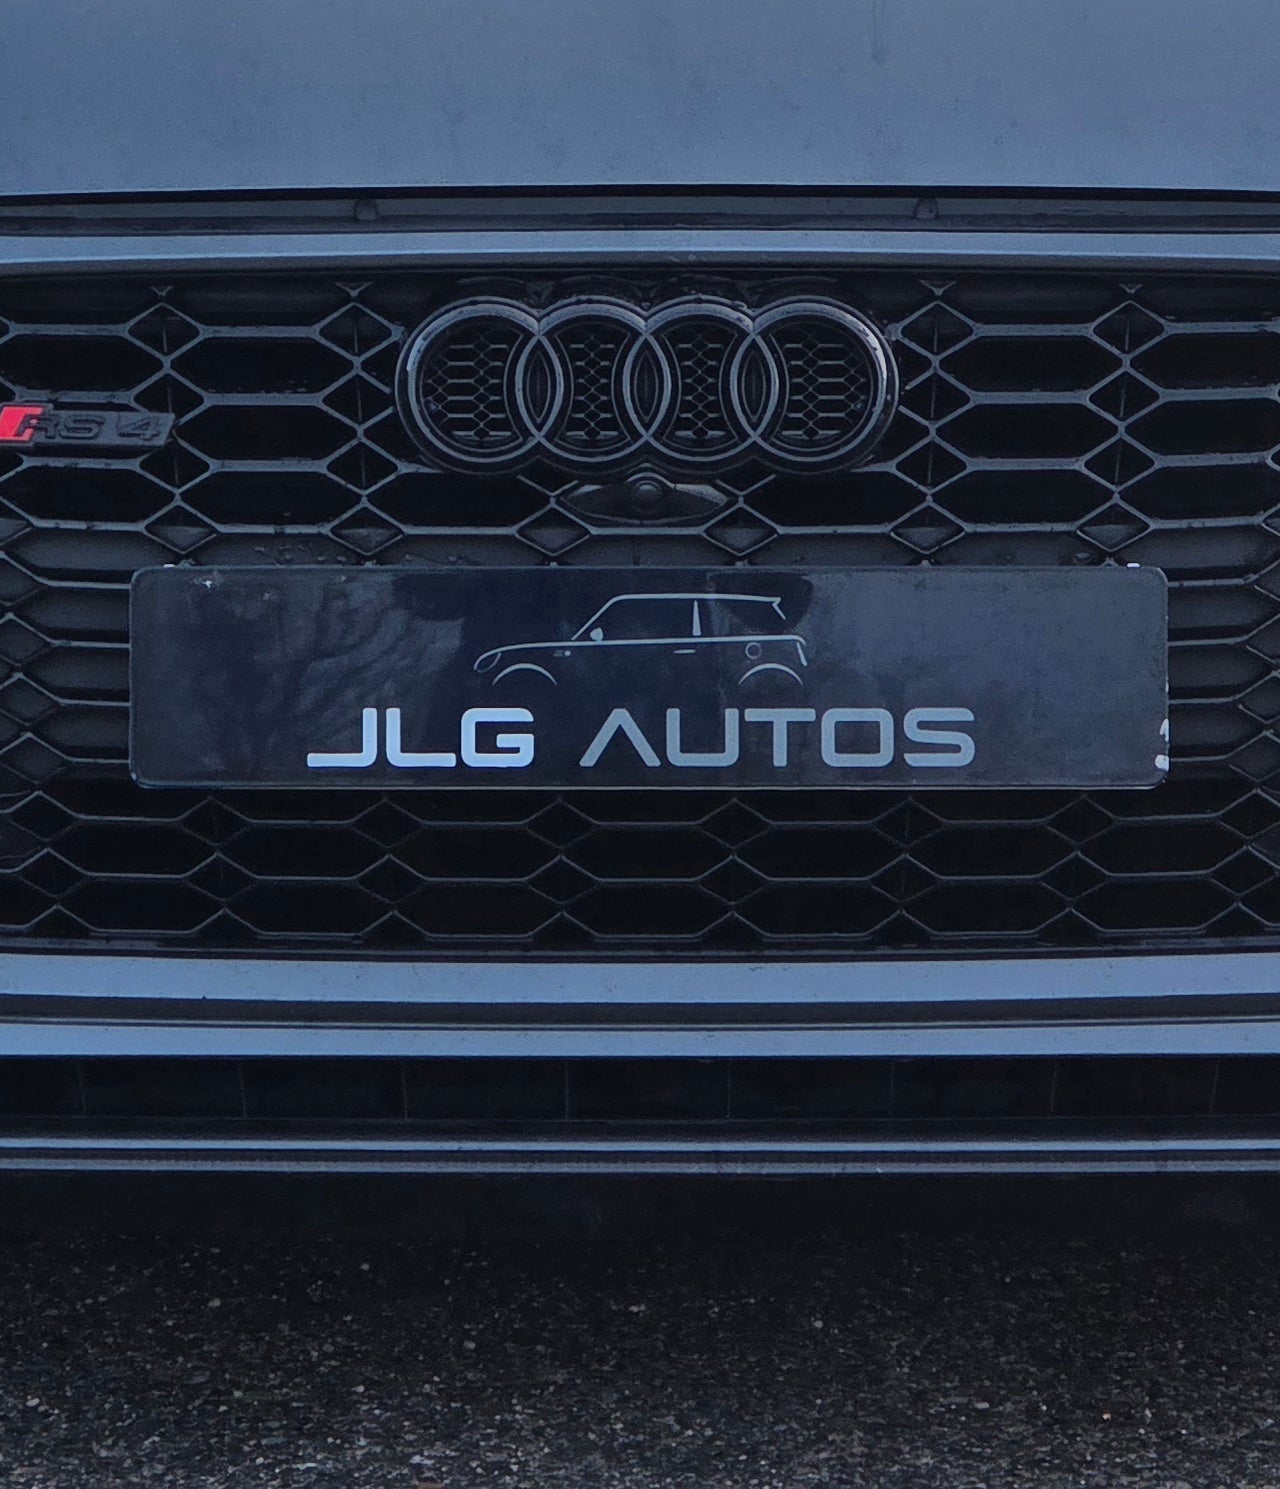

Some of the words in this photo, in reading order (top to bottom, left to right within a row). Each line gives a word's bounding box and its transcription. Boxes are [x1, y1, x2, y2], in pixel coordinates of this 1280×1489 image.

[12, 412, 106, 441] RS
[118, 413, 162, 441] 4
[305, 707, 536, 769] JLG
[578, 706, 977, 769] AUTOS
